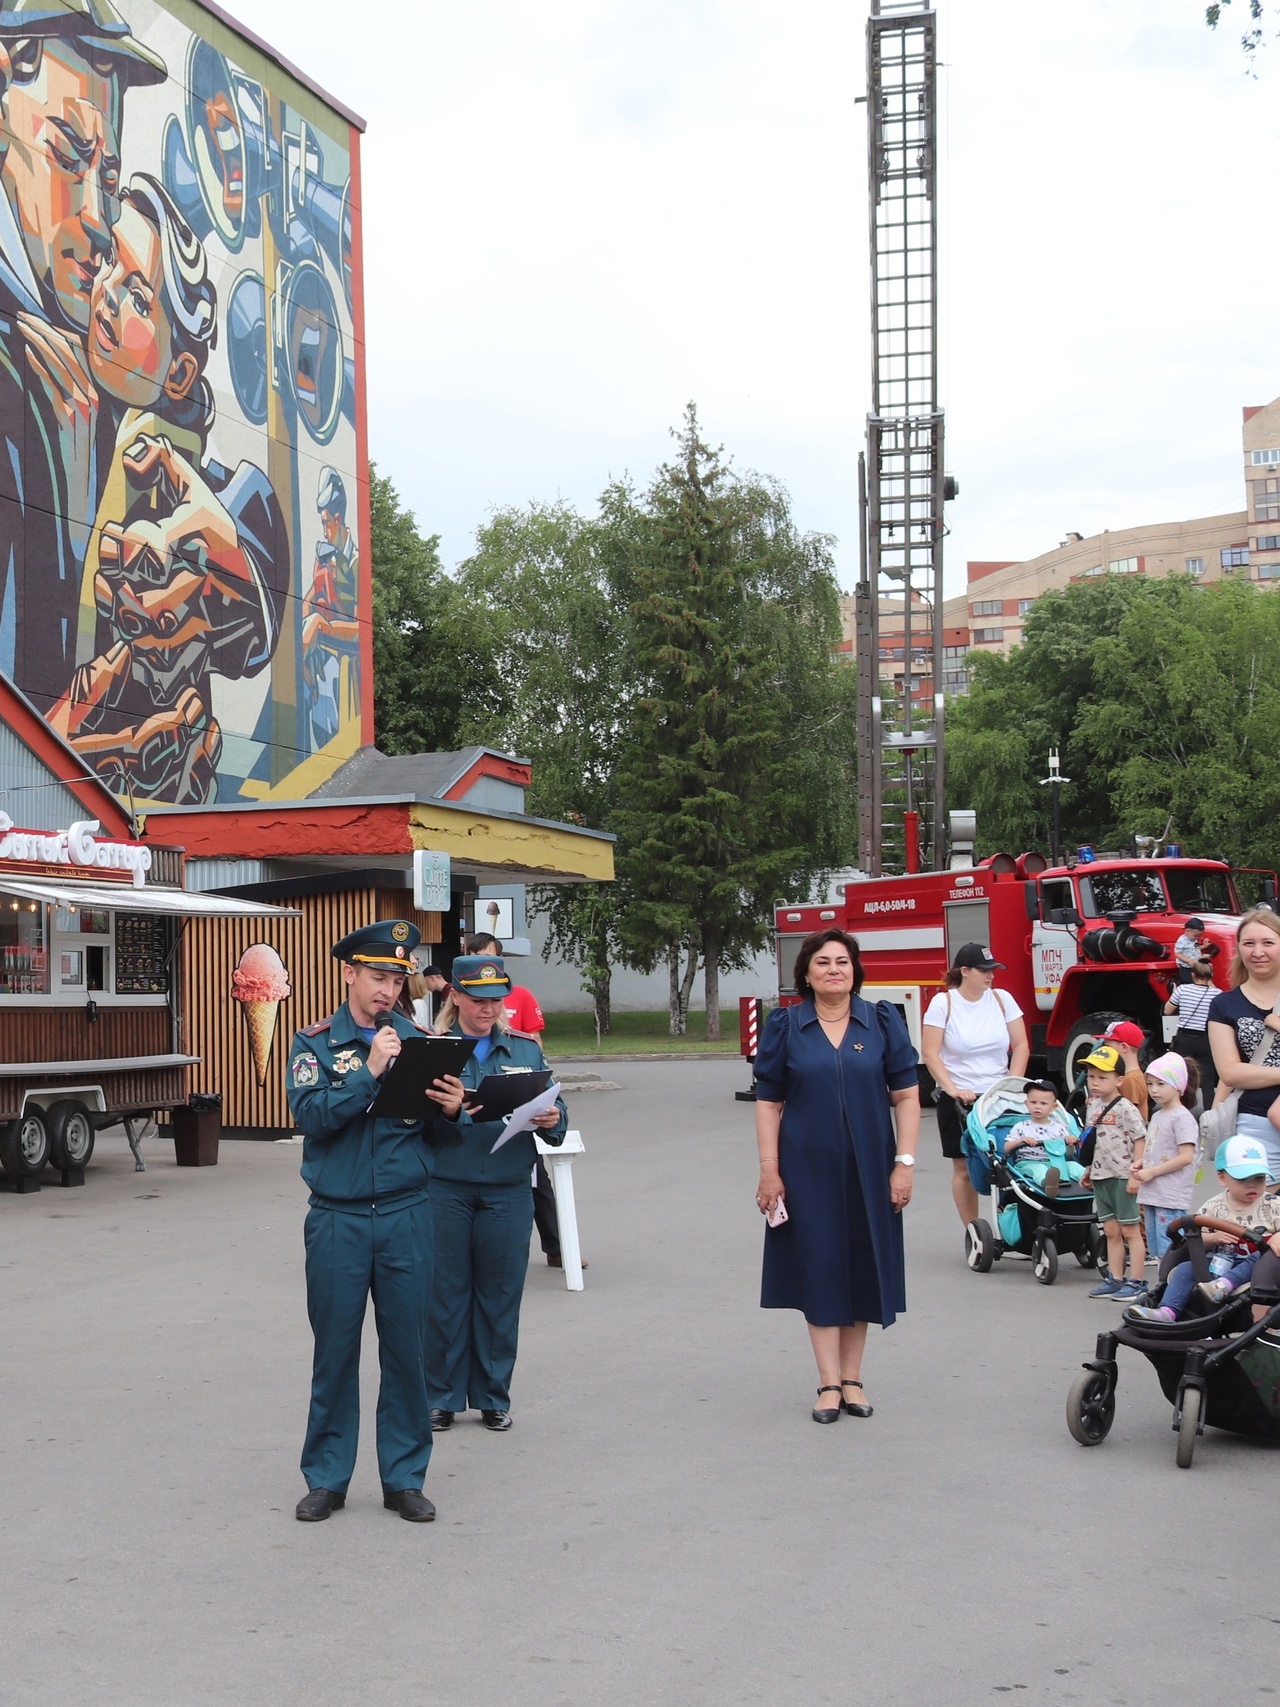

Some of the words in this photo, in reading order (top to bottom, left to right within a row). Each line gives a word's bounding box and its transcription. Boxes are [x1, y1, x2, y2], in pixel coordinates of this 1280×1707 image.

[424, 867, 448, 888] CARTE
[949, 888, 975, 899] ТЕЛЕФОН
[975, 886, 984, 896] 112
[1041, 949, 1062, 963] МПЧ
[1045, 963, 1064, 972] МАРТА
[1044, 973, 1062, 985] УФА
